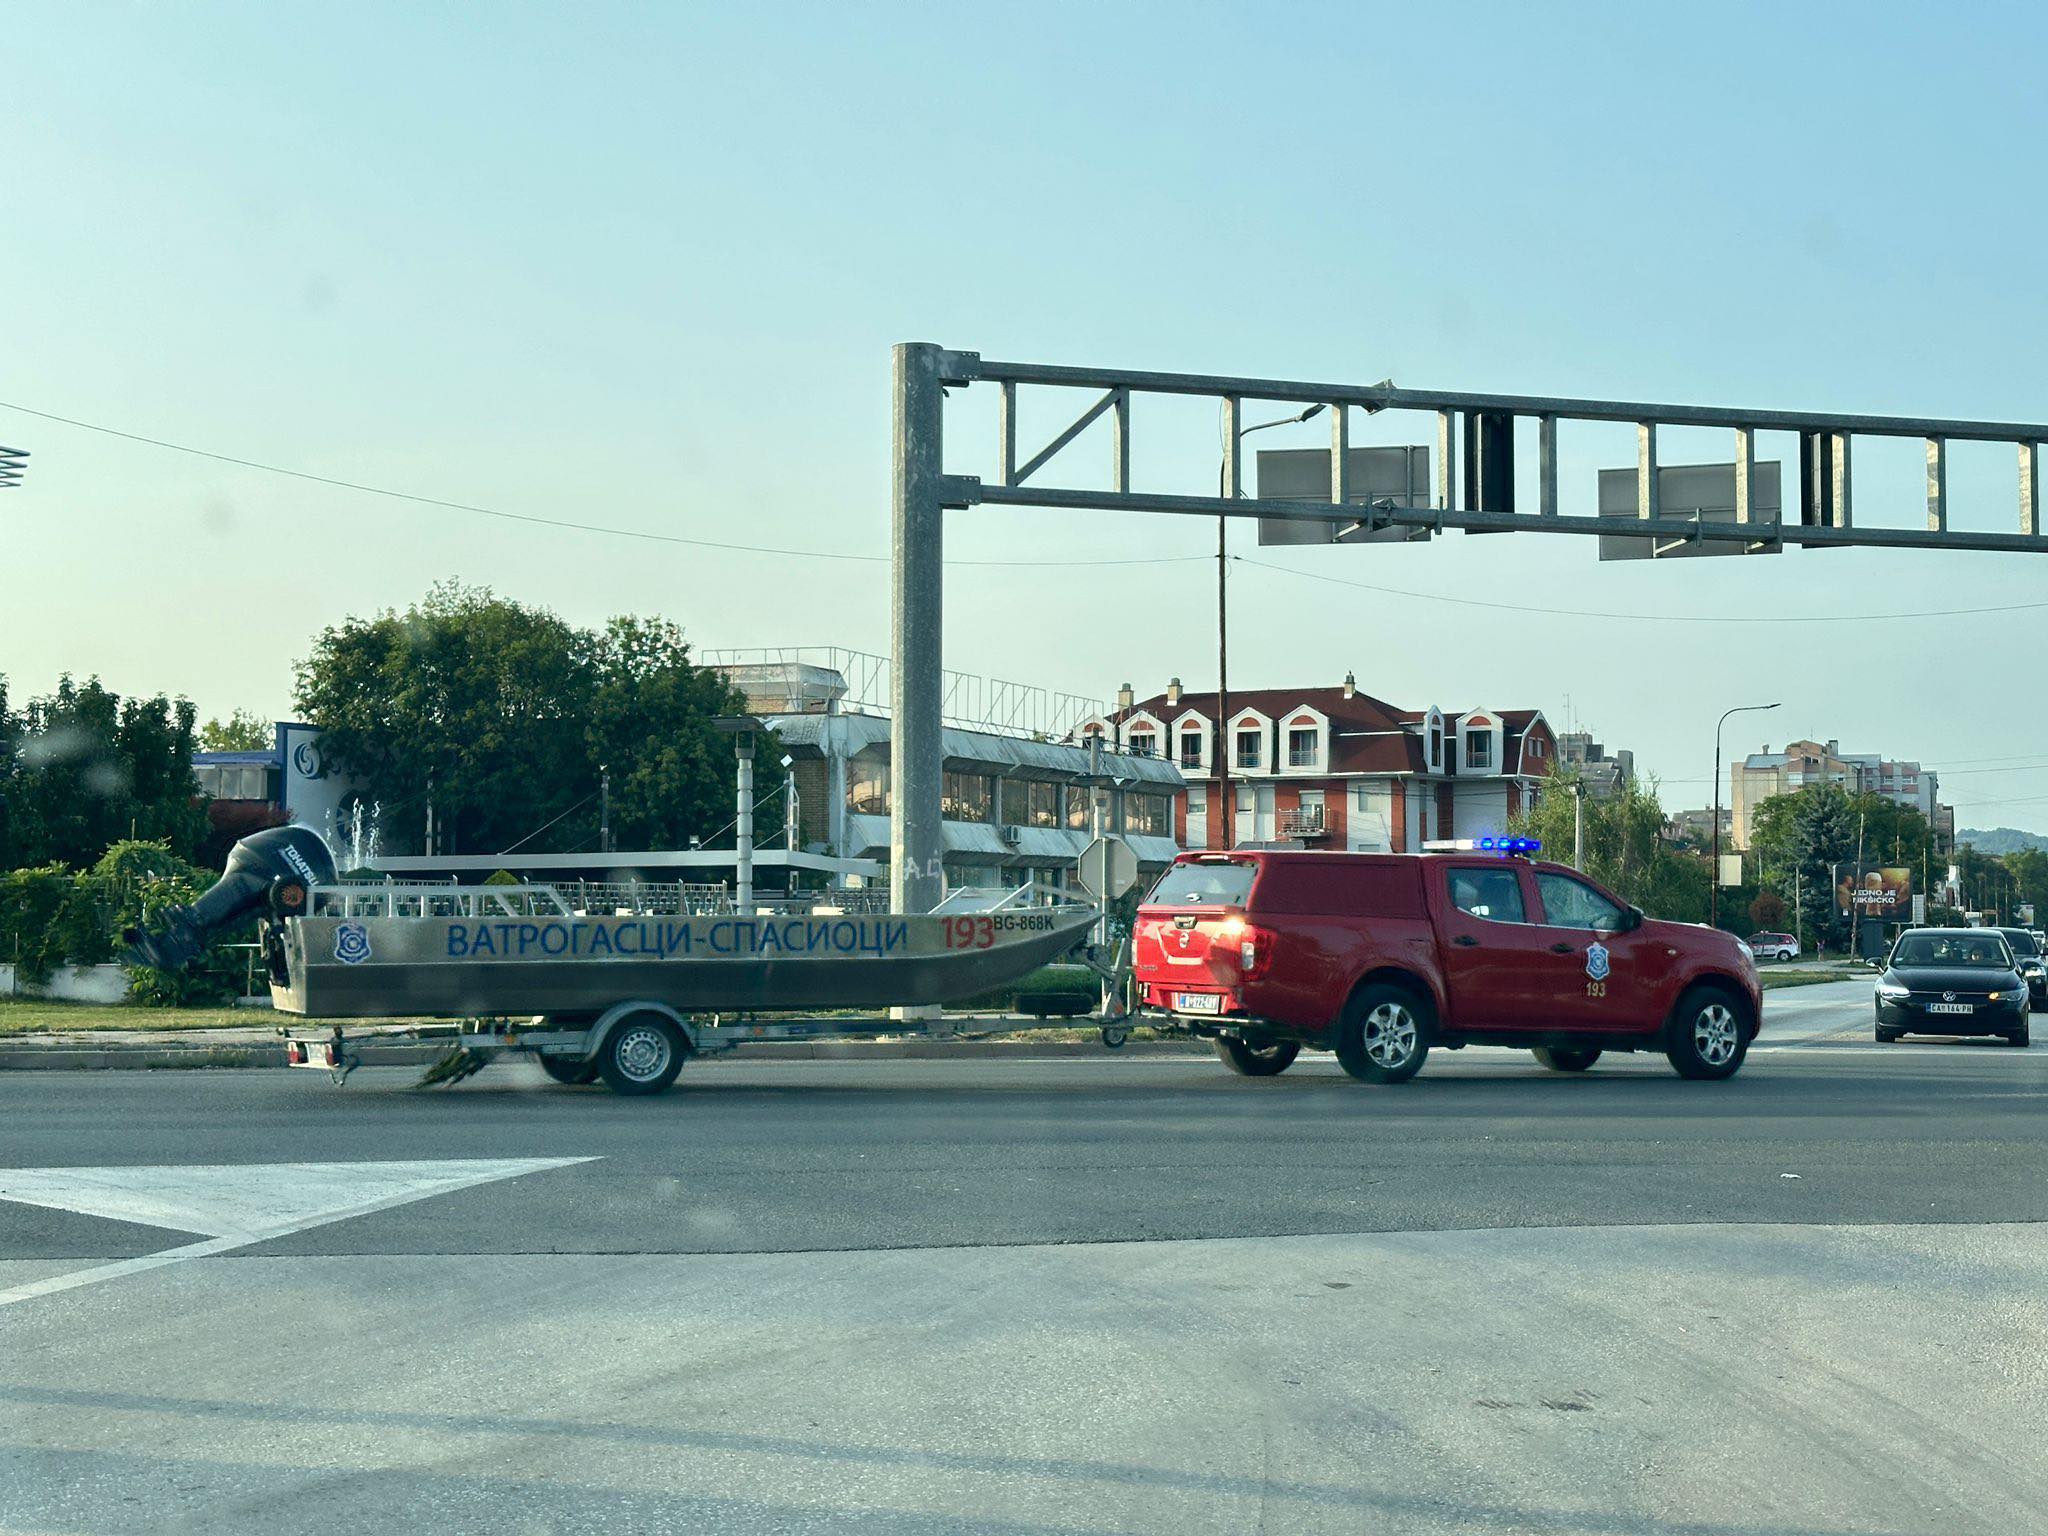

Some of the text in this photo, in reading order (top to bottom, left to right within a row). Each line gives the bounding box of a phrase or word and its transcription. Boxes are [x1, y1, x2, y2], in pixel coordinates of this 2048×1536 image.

[284, 844, 319, 886] TOHATSU
[940, 916, 994, 948] 193
[993, 915, 1055, 931] BG-868K
[447, 922, 907, 959] ВАТРОГАСЦИ-СПАСИОЦИ
[1586, 982, 1606, 998] 193
